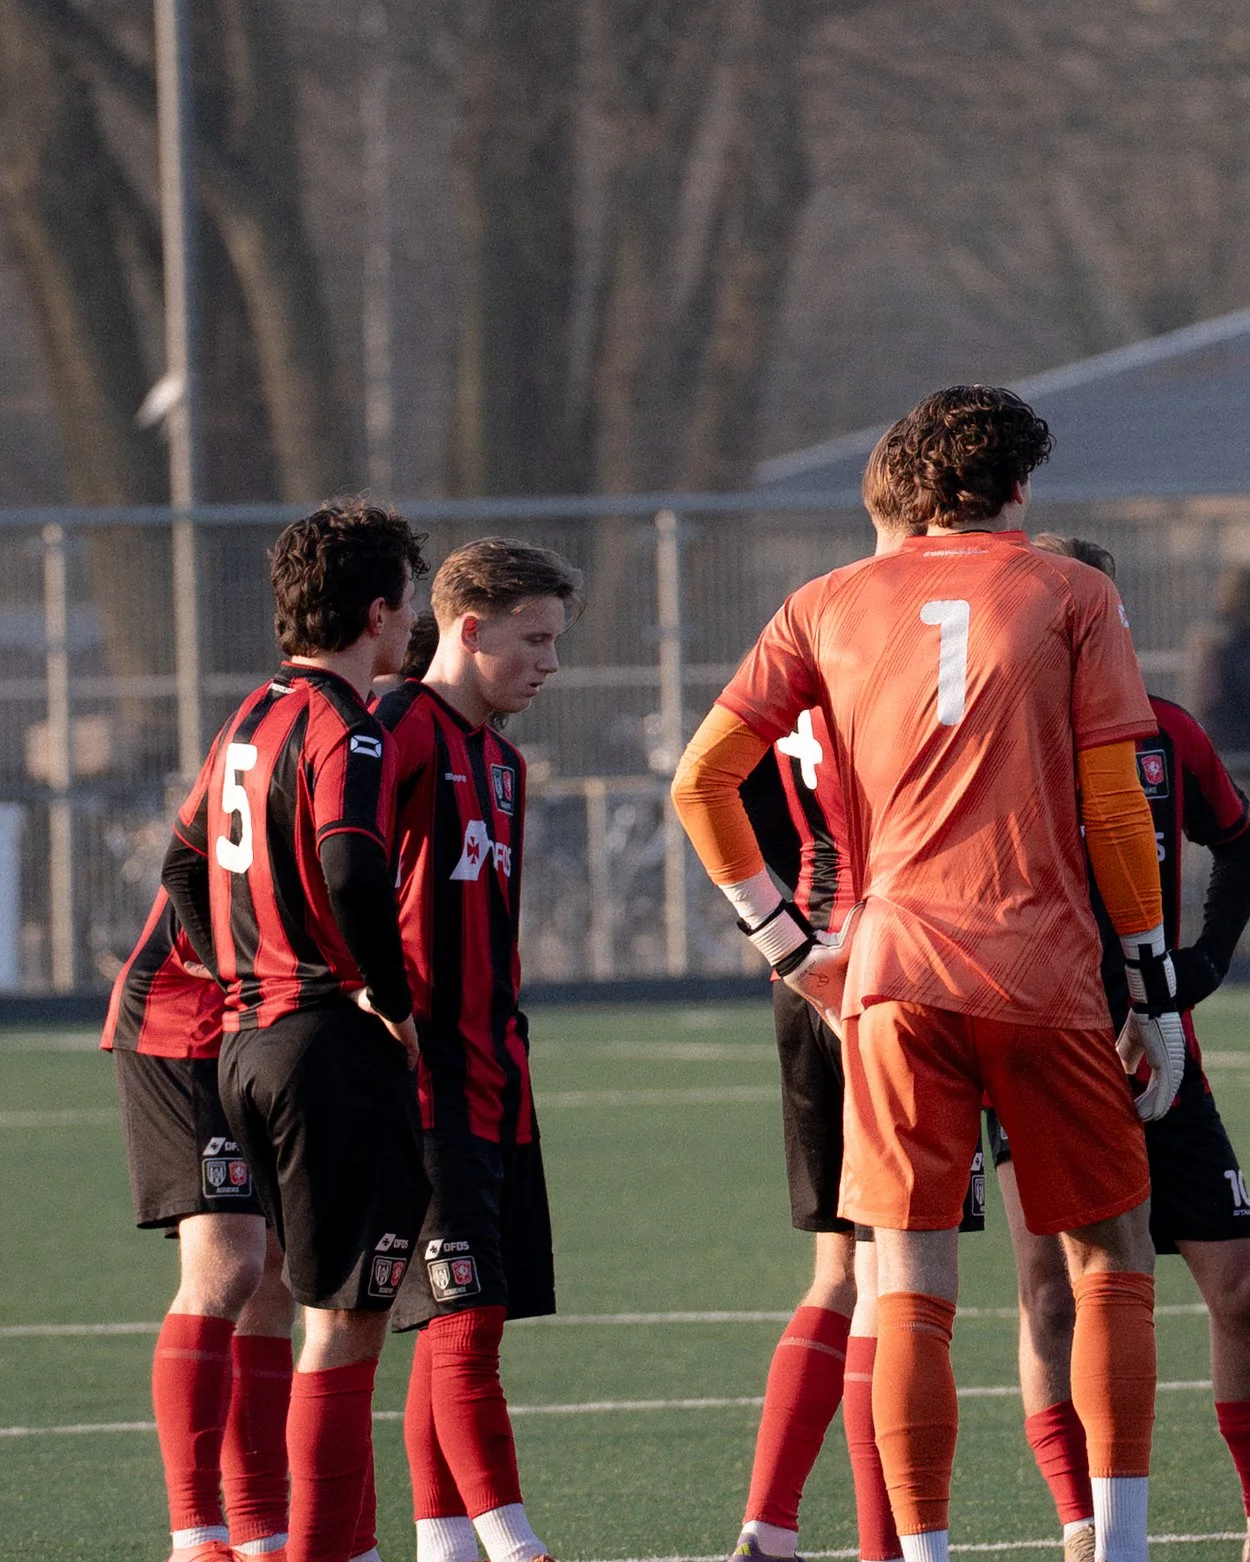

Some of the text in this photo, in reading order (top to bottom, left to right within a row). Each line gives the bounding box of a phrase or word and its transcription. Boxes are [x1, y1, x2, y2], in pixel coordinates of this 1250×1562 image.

[920, 600, 970, 726] 1
[216, 743, 257, 874] 5
[776, 709, 823, 790] 4
